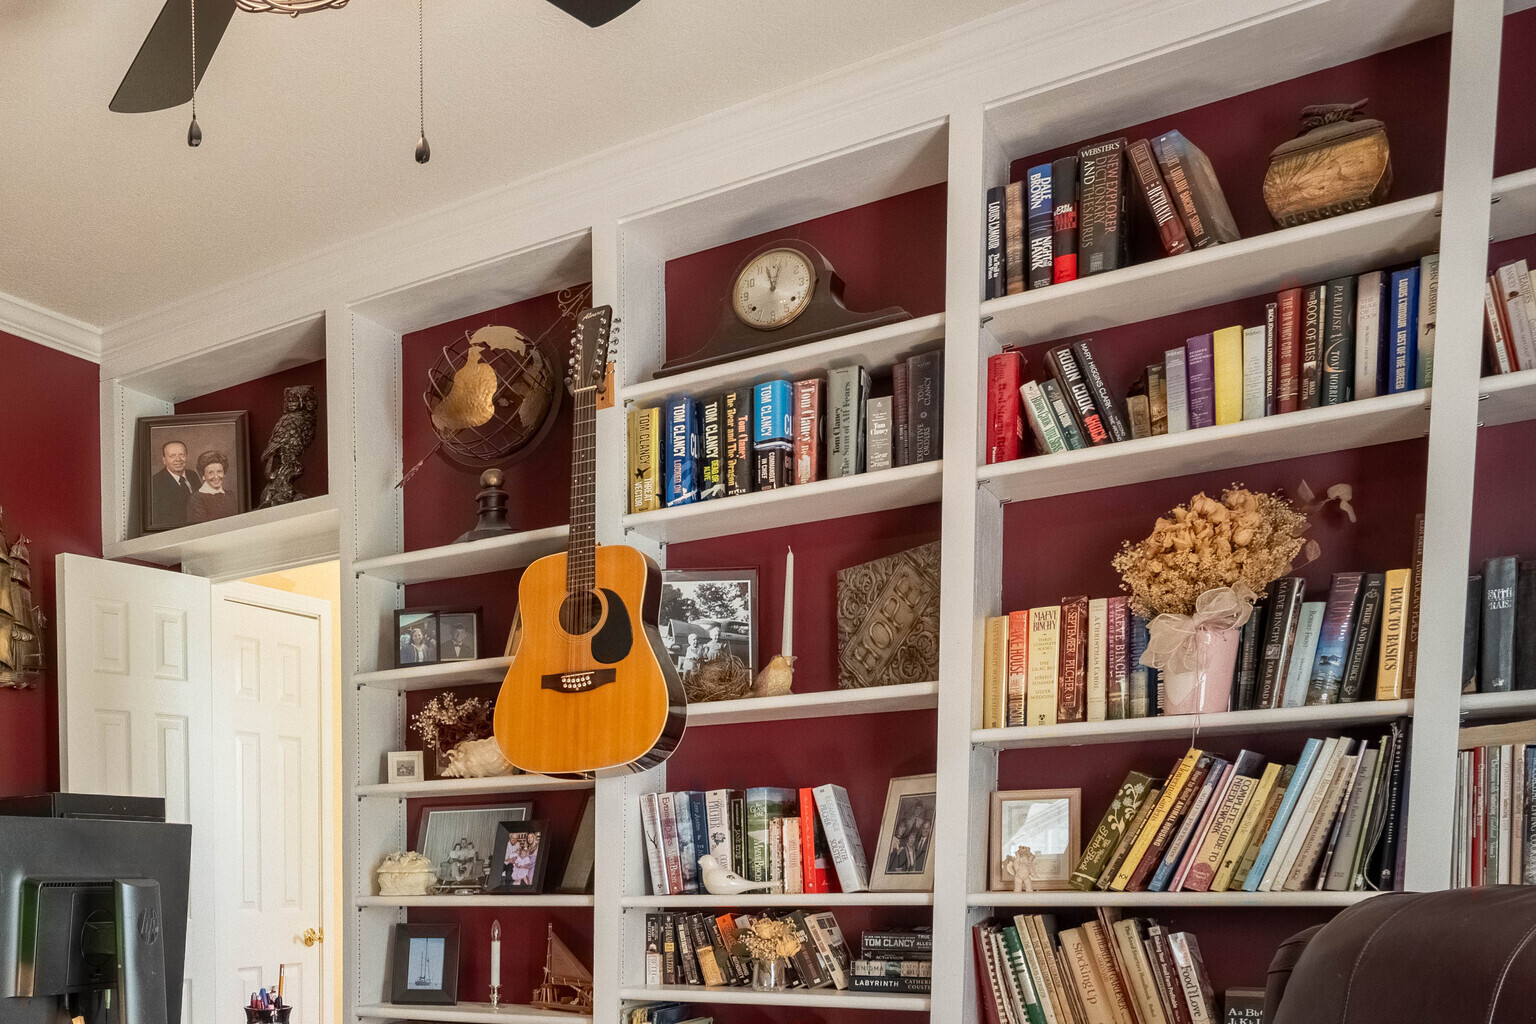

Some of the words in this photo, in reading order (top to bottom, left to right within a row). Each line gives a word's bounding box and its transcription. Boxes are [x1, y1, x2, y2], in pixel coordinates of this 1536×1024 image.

[1081, 142, 1120, 158] WEBSTER'S
[1084, 161, 1095, 185] AND
[1107, 153, 1118, 178] NEW
[1030, 172, 1042, 210] BROWN
[1041, 176, 1052, 200] DALE
[1094, 157, 1107, 224] DICTIONARY
[1105, 179, 1118, 236] EXPLORER
[1147, 185, 1174, 226] BETRAYAL
[1082, 186, 1094, 248] THESAURUS
[1032, 237, 1043, 270] HAWK
[1042, 235, 1052, 258] NIGHT
[793, 265, 799, 274] 2
[1429, 260, 1439, 281] JOHN
[747, 279, 755, 288] 10
[799, 277, 804, 286] 3
[1399, 278, 1408, 301] LOUIS
[744, 292, 748, 301] 9
[1283, 297, 1293, 309] THE
[1428, 282, 1438, 316] GRISHAM
[770, 310, 776, 320] 6
[784, 304, 790, 312] 5
[1283, 310, 1293, 320] DA
[1306, 300, 1317, 327] BOOK
[1332, 285, 1344, 331] PARADISE
[1398, 302, 1408, 330] L'AMOUR
[1282, 320, 1292, 340] VINCI
[1306, 328, 1316, 342] OF
[1397, 330, 1406, 346] LAST
[1282, 340, 1292, 358] CODE
[1305, 344, 1316, 362] LIES
[1396, 347, 1406, 356] OF
[1396, 356, 1406, 368] THE
[1080, 342, 1092, 360] MARY
[1087, 356, 1104, 390] HIGGINS
[1099, 387, 1112, 410] CLARK
[1395, 368, 1405, 390] BREED
[761, 384, 772, 403] TOM
[843, 380, 851, 407] Fears
[1057, 348, 1081, 382] ROBIN
[1072, 381, 1095, 414] COOK
[1084, 414, 1108, 444] SHOCK
[1308, 380, 1316, 396] BRAD
[727, 393, 736, 406] The
[639, 413, 650, 433] TOM
[673, 404, 686, 422] TOM
[705, 402, 718, 423] TOM
[726, 408, 736, 426] Bear
[738, 415, 748, 432] Tom
[761, 404, 772, 437] CLANCY
[834, 406, 844, 436] Clancy
[673, 423, 686, 456] CLANCY
[727, 427, 736, 441] and
[842, 424, 850, 433] of
[870, 428, 888, 436] Clancy
[639, 434, 650, 468] CLANCY
[705, 424, 718, 458] CLANCY
[727, 442, 736, 458] The
[738, 433, 748, 460] Clancy
[833, 436, 842, 455] Tom
[842, 434, 850, 455] Sum
[673, 459, 682, 483] LOCKED
[762, 457, 768, 465] IN
[768, 451, 776, 483] COMMANDER
[711, 473, 719, 482] OR
[727, 459, 738, 486] Dragon
[634, 481, 642, 506] VECTOR
[644, 478, 652, 501] THREAT
[673, 484, 682, 494] ON
[1276, 579, 1288, 610] MAEVE
[1390, 587, 1403, 616] BACK
[1488, 587, 1512, 600] FAITH
[852, 571, 925, 674] HOPE
[1033, 610, 1058, 621] MAEVE
[1115, 602, 1126, 640] MAEVE
[1306, 610, 1316, 630] ROBERT
[1362, 603, 1374, 624] PRIDE
[1388, 616, 1400, 630] TO
[1033, 620, 1057, 632] BINCHY
[1066, 611, 1078, 656] SEPTEMBER
[1271, 611, 1282, 643] BINCHY
[1360, 626, 1369, 642] AND
[1302, 631, 1312, 648] FROST
[1349, 641, 1365, 681] PREJUDICE
[1384, 632, 1400, 671] BASICS
[1115, 643, 1126, 683] BINCHY
[1264, 661, 1274, 679] TARA
[1064, 658, 1076, 694] PILCHER
[1263, 680, 1272, 700] ROAD
[1193, 770, 1202, 782] How
[1211, 777, 1242, 834] NEEDLEWORK
[1230, 779, 1252, 821] COMPLETE
[708, 801, 720, 829] PILCHER
[820, 804, 832, 826] PILCHER
[1168, 800, 1186, 824] ANIMAL
[1091, 825, 1109, 852] Herb
[1153, 820, 1172, 846] HOUSING
[1219, 822, 1234, 850] GUIDE
[830, 838, 842, 865] SOLSTICE
[838, 839, 849, 862] WINTER
[1079, 847, 1098, 871] Book
[1209, 850, 1221, 862] TO
[864, 938, 881, 947] TOM
[882, 939, 915, 948] CLANCY
[856, 964, 885, 972] ENIGMA
[1072, 942, 1092, 990] Stocking
[1086, 988, 1098, 1005] Up
[854, 979, 899, 988] LABYRINTH
[1181, 965, 1194, 989] Food
[1190, 993, 1202, 1018] Love
